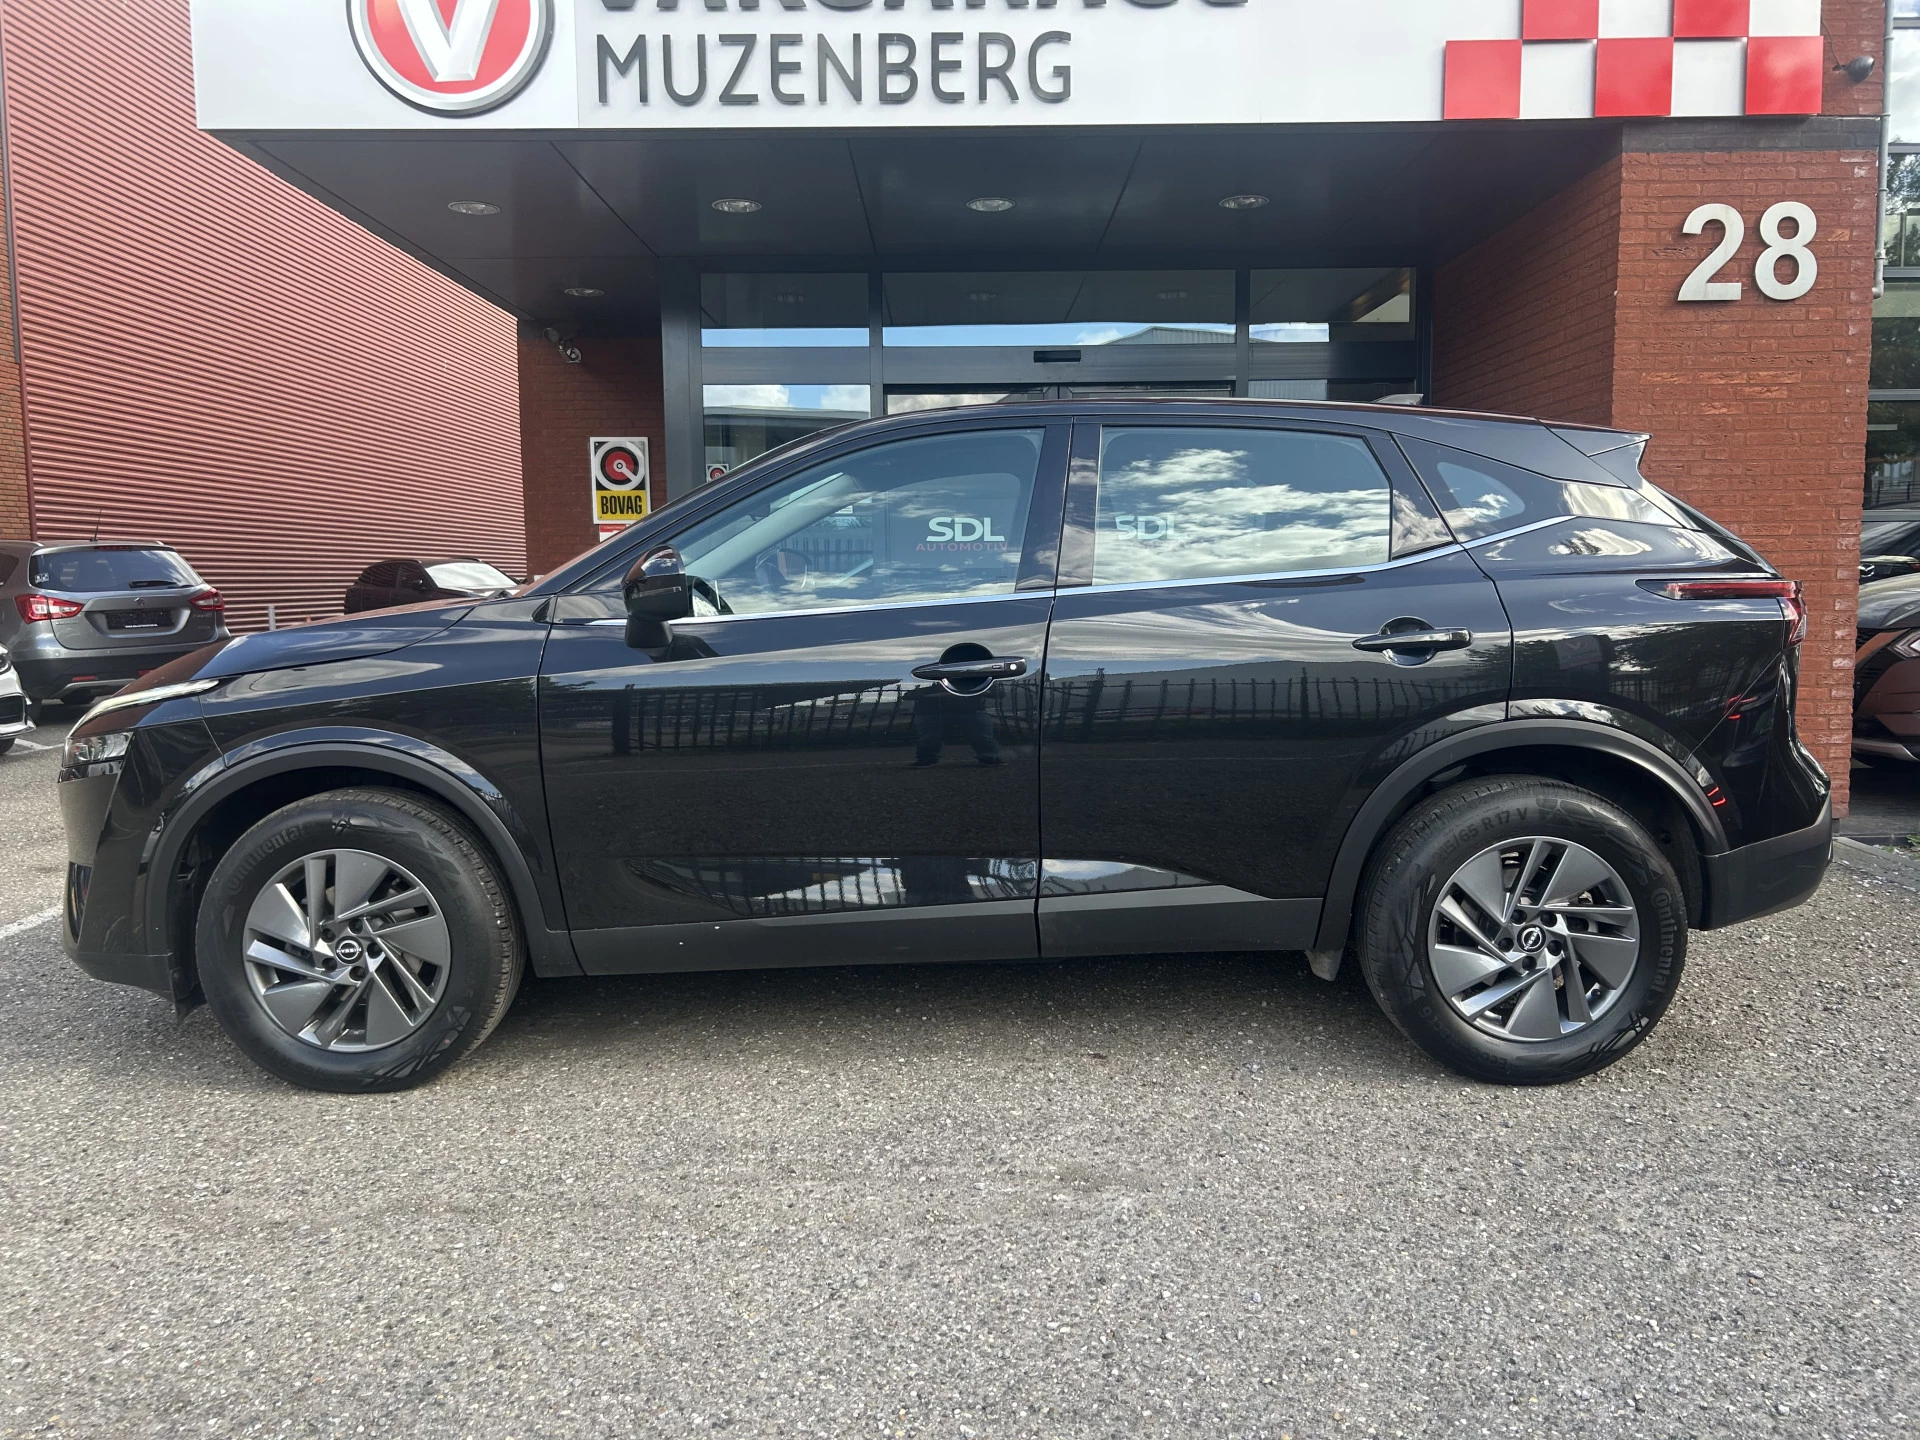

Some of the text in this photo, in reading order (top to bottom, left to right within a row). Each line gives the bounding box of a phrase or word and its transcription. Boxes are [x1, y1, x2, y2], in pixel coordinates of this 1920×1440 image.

[597, 31, 1072, 106] MUZENBERG
[1677, 201, 1818, 301] 28
[601, 495, 643, 515] BOVAG
[926, 516, 1006, 542] SDL
